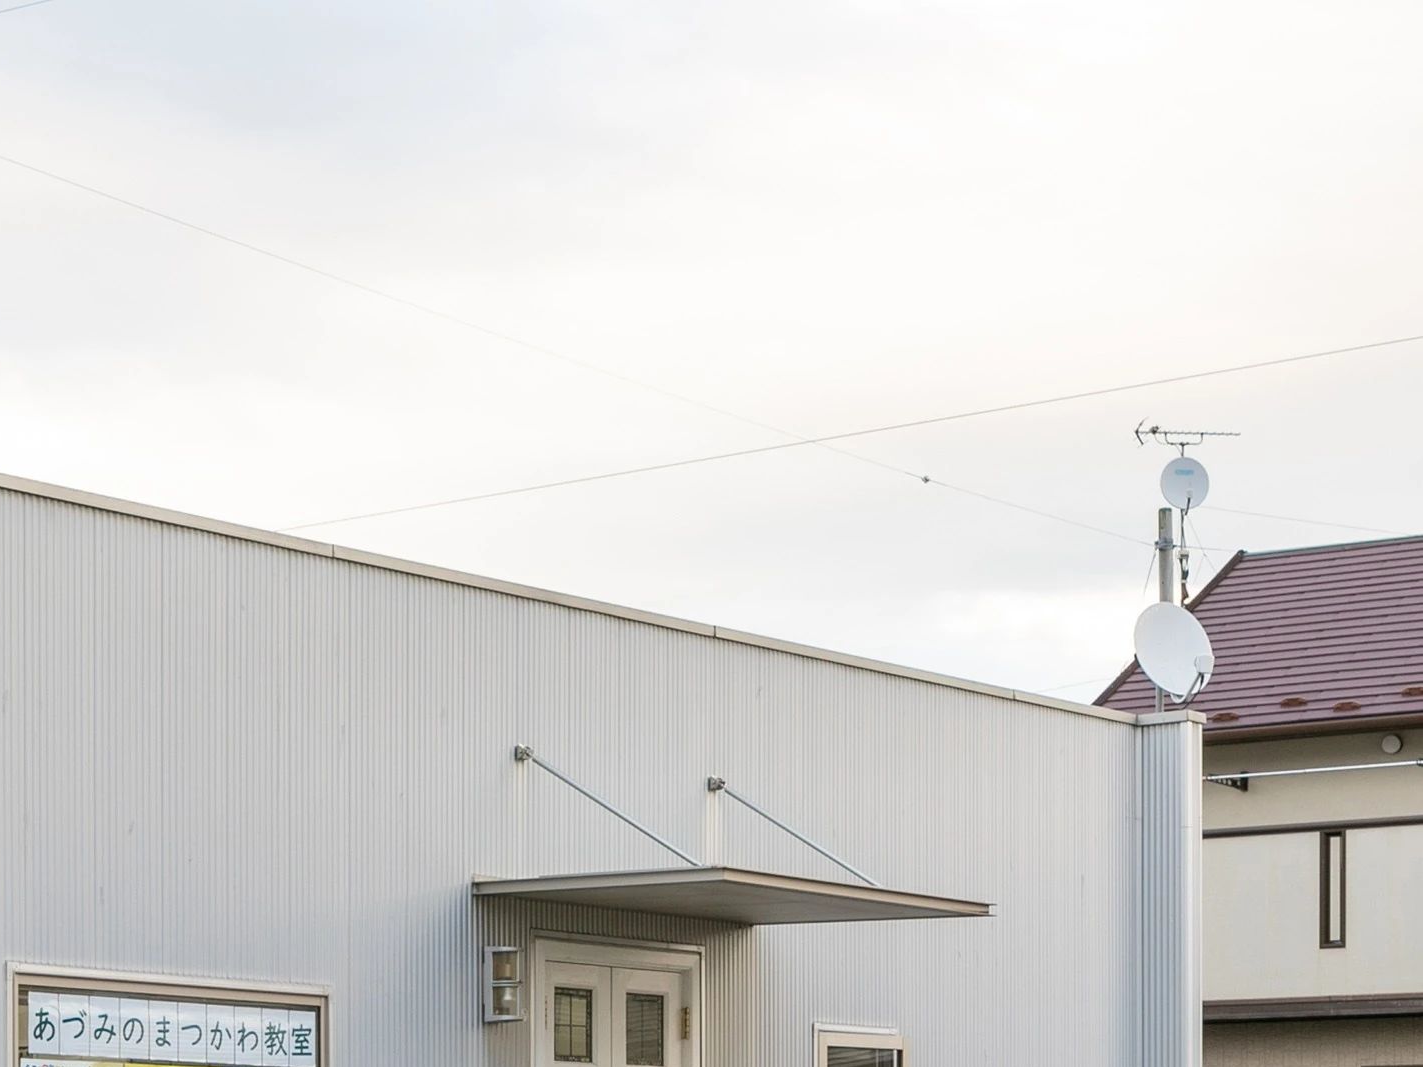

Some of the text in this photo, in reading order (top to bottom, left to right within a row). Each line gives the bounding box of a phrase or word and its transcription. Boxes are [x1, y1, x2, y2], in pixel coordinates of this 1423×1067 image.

[33, 1008, 313, 1056] あづみのまつかわ教室
